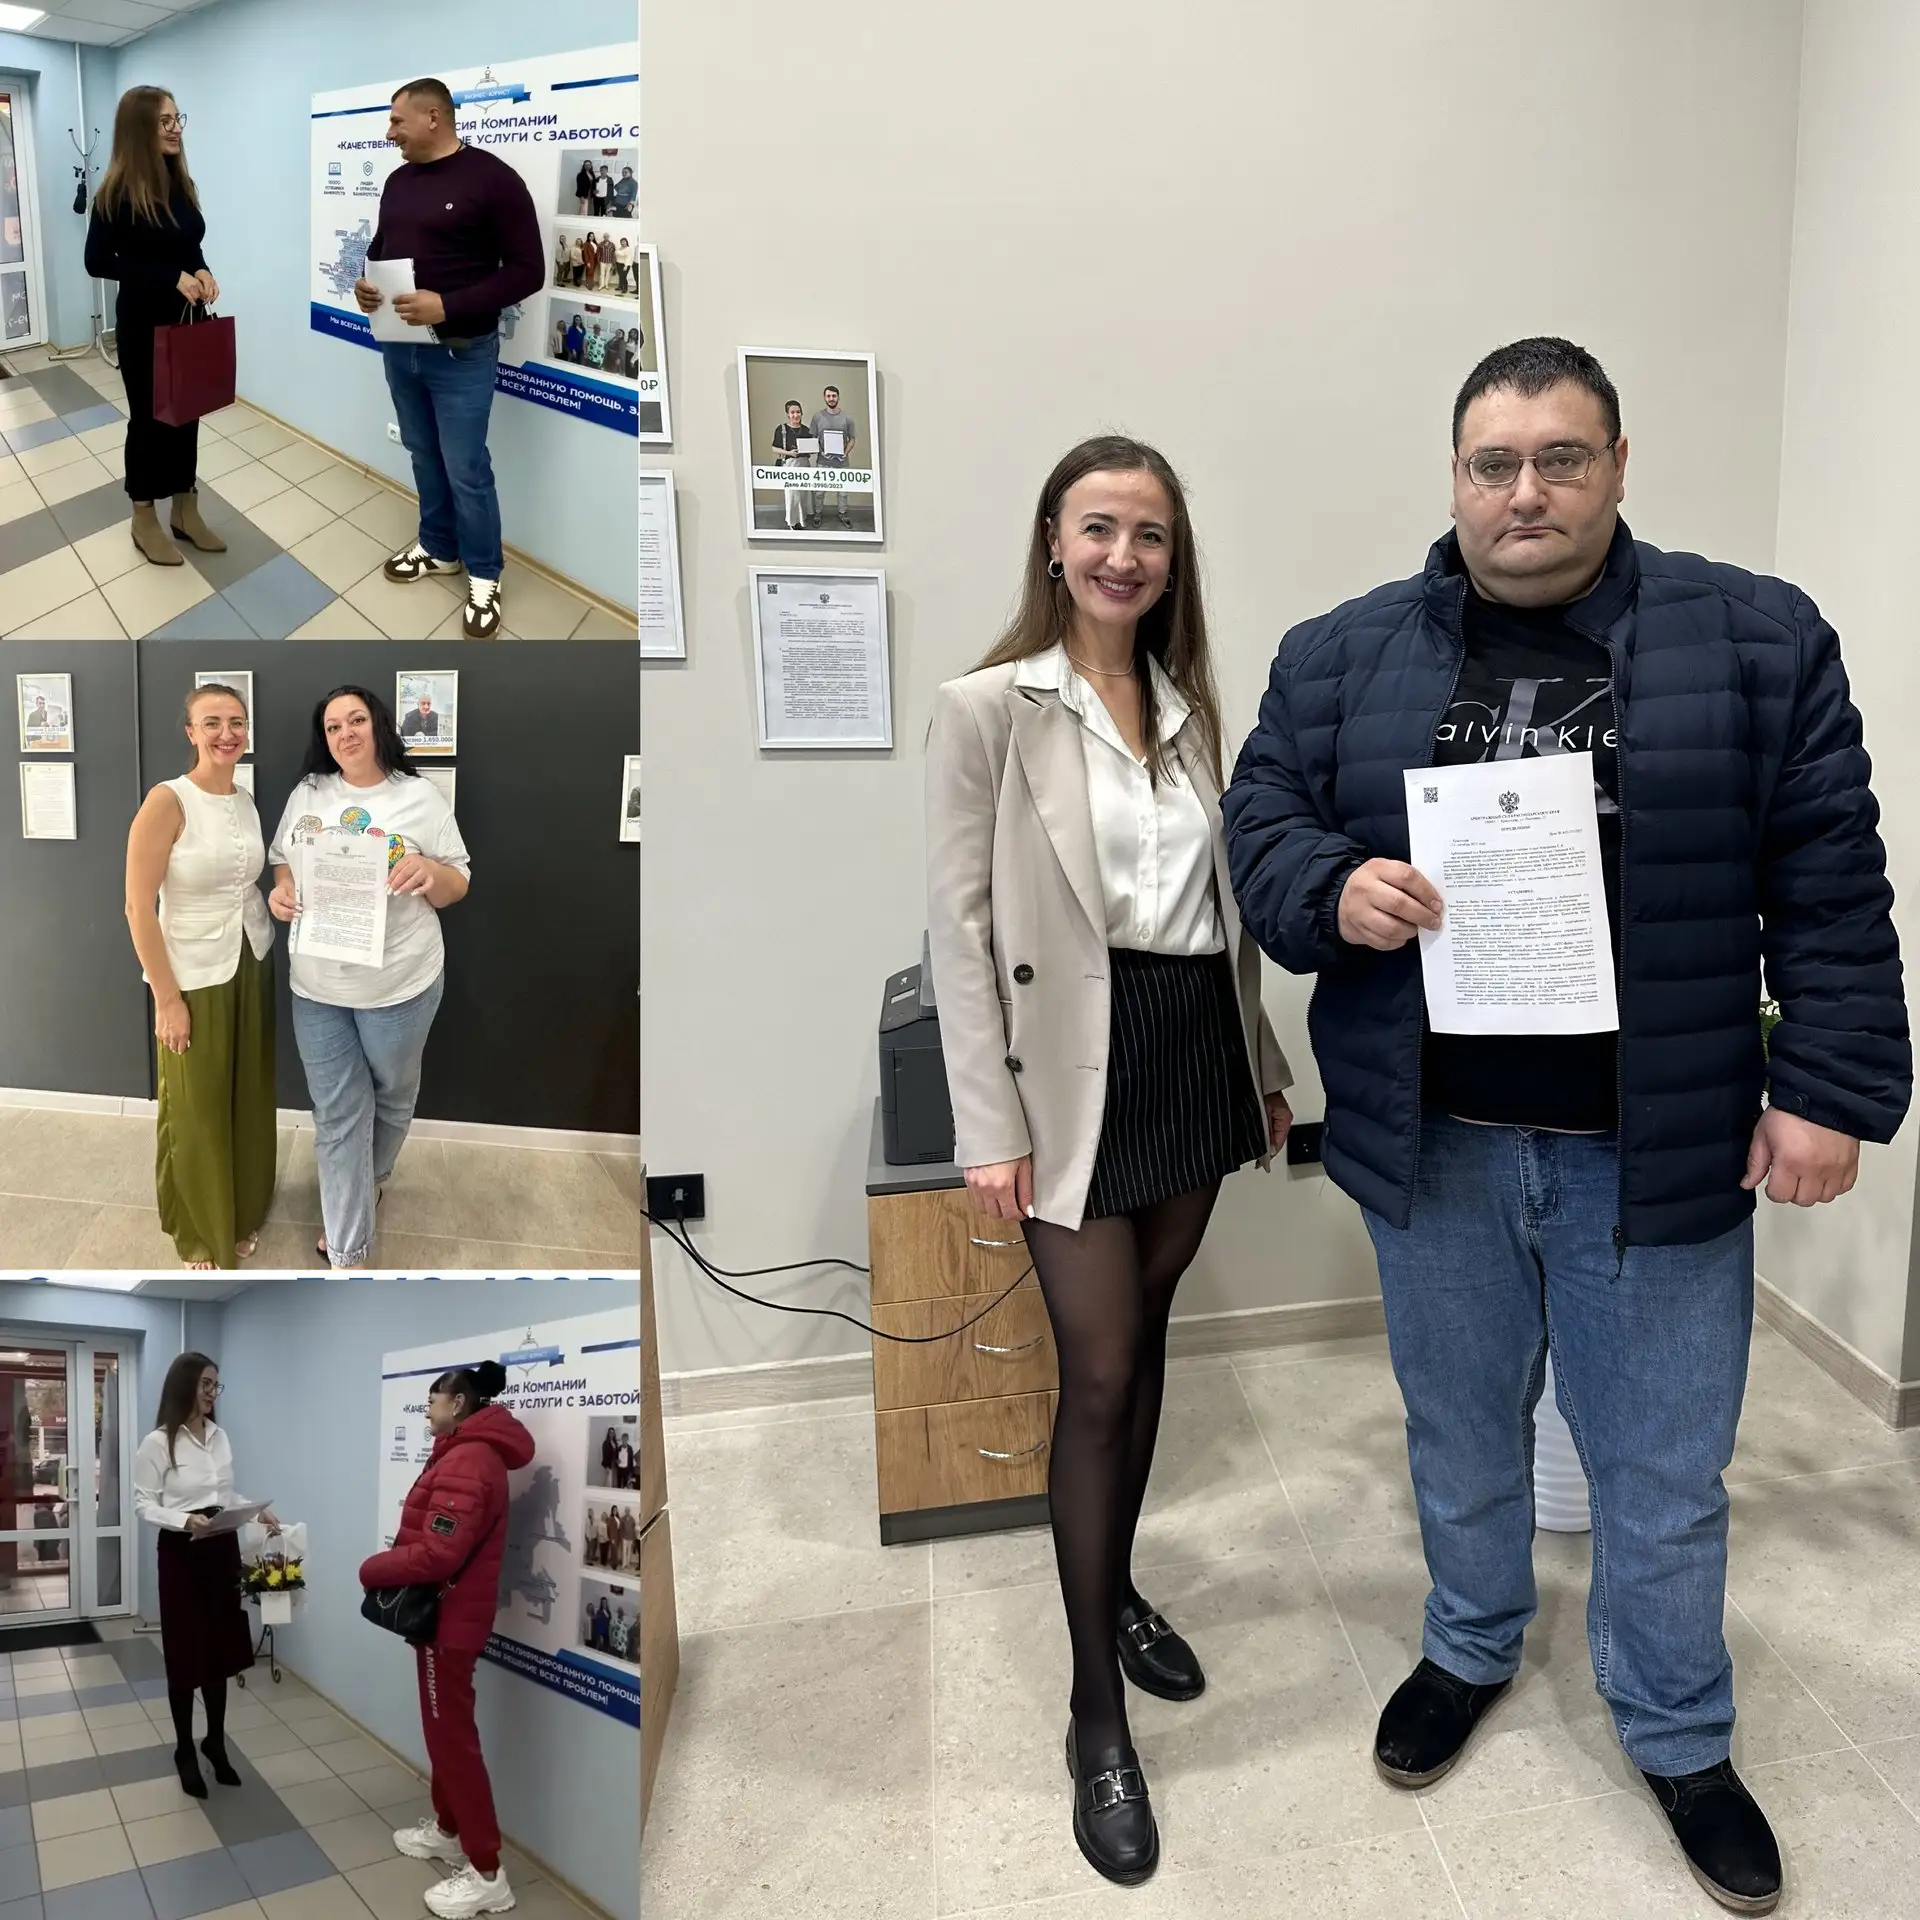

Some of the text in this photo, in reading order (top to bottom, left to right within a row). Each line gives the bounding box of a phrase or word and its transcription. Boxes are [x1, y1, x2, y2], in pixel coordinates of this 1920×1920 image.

[477, 131, 528, 144] УСЛУГИ
[533, 131, 543, 141] С
[548, 123, 622, 141] ЗАБОТОЙ
[340, 319, 361, 332] ВСЕГДА
[501, 379, 581, 411] ВСЕХ ПРОБЛЕМ!
[570, 388, 625, 412] ПОМОЩЬ,
[756, 468, 871, 483] Списано 419.000₽
[519, 1396, 562, 1410] УСЛУГИ
[567, 1397, 574, 1407] С
[578, 1389, 640, 1407] ЗАБОТОЙ
[539, 1668, 561, 1685] ВСЕХ
[563, 1679, 609, 1706] ПРОБЛЕМ!
